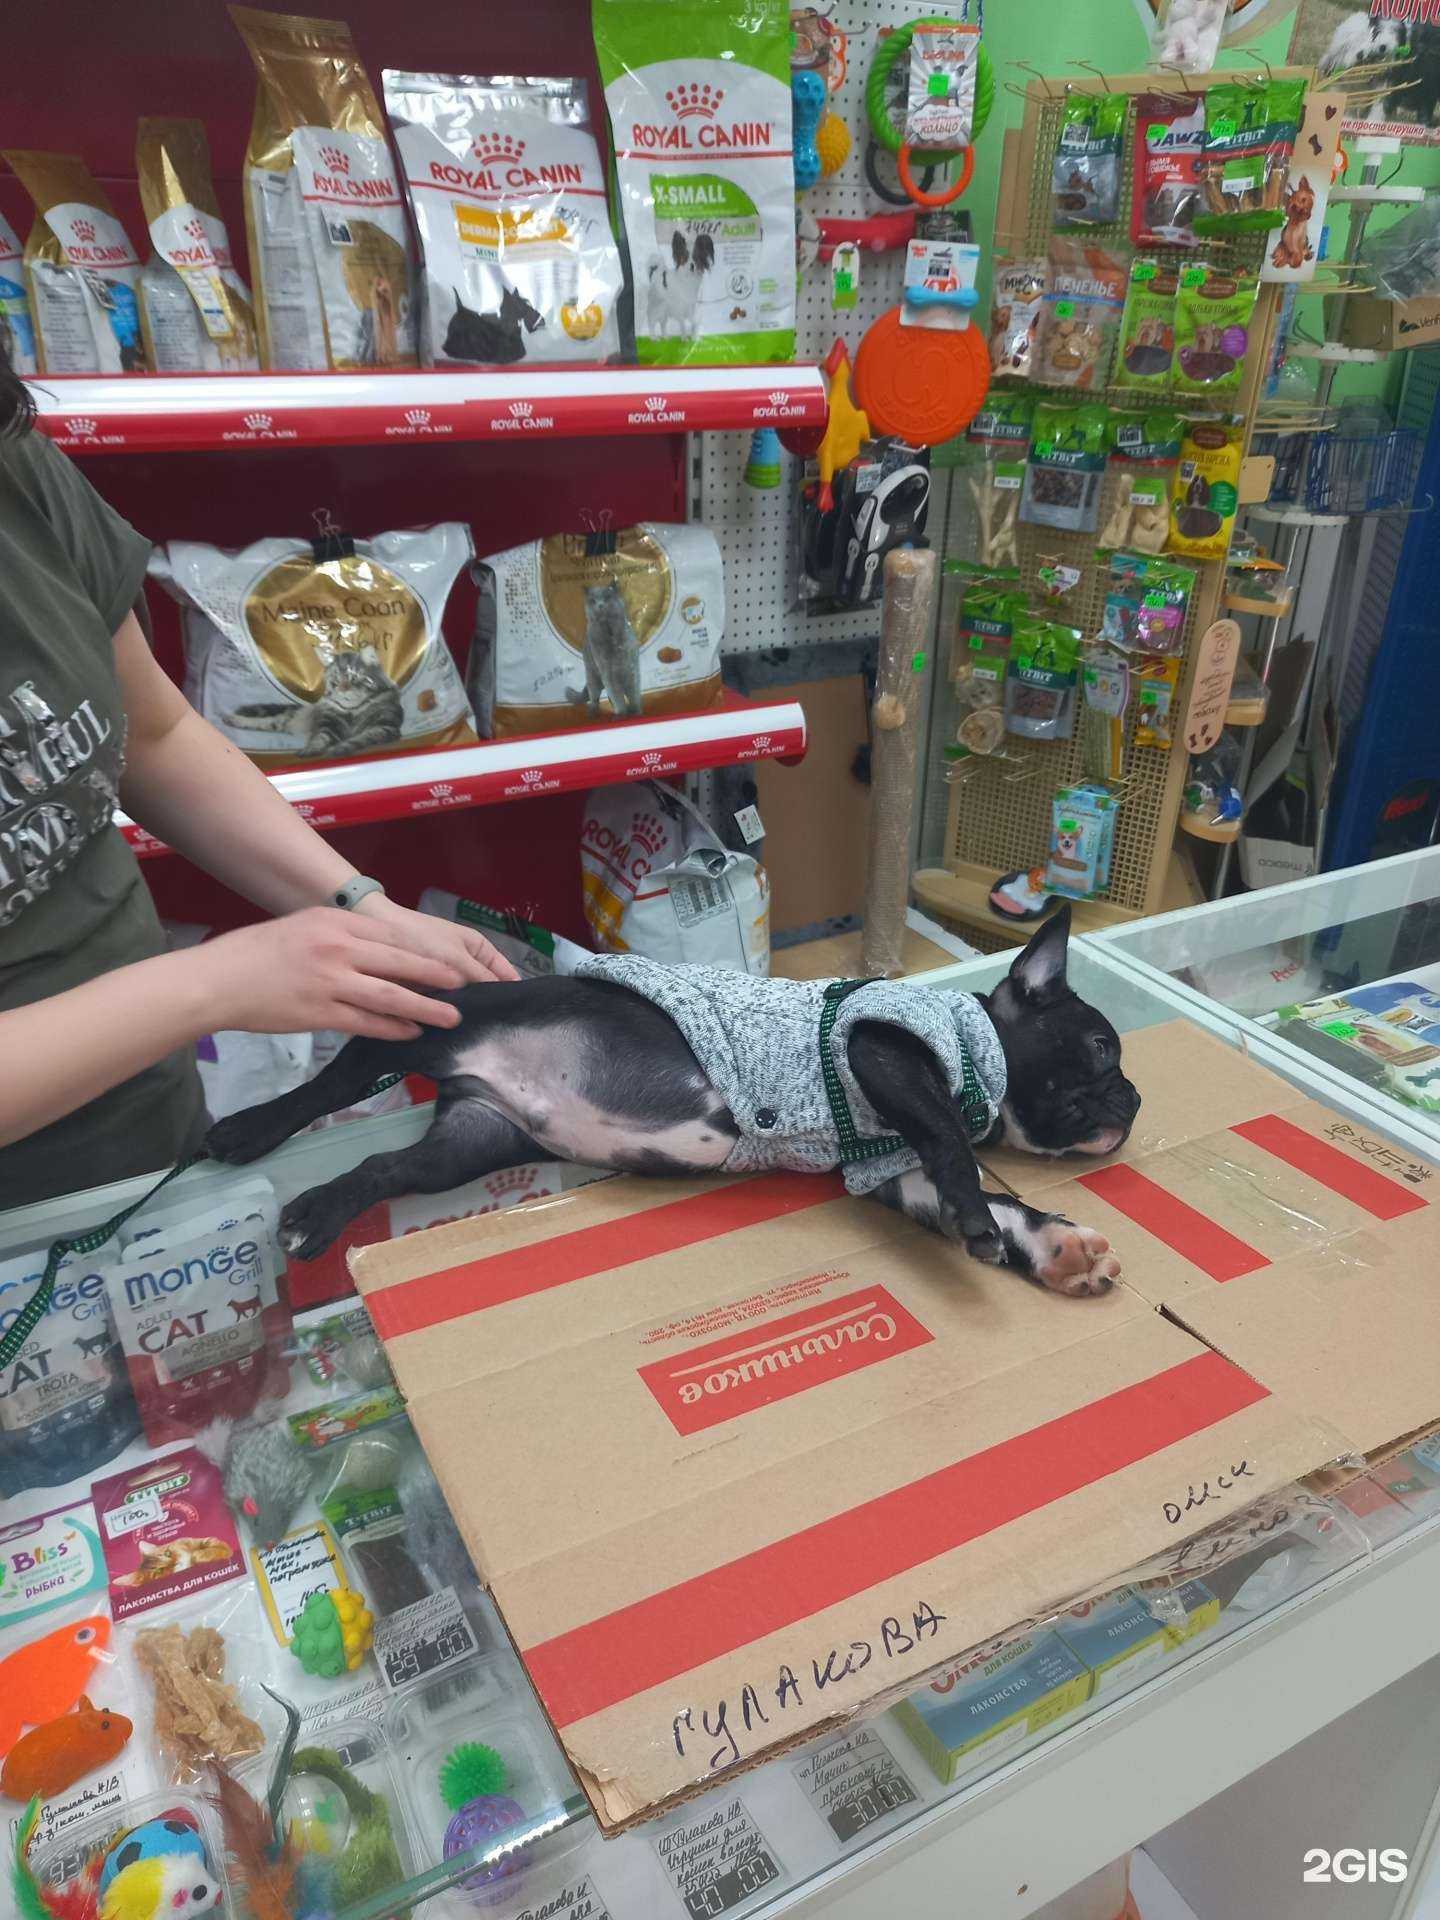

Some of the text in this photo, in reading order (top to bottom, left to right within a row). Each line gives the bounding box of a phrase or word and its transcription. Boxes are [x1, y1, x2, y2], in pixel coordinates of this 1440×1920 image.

[633, 122, 772, 149] ROYAL CANIN
[429, 161, 585, 192] ROYAL CANIN
[654, 184, 726, 206] X-SMALL
[475, 246, 499, 258] MINI
[1054, 275, 1118, 297] ПЕЧЕНЬЕ
[491, 415, 554, 430] ROYAL CANIN
[628, 410, 685, 424] ROYAL CANIN
[753, 405, 806, 418] ROYAL CANIN
[342, 596, 407, 619] Coon
[583, 818, 633, 871] ROYAL
[228, 1256, 264, 1287] Grill
[71, 1288, 112, 1322] Grill
[138, 1309, 209, 1355] CAT
[181, 1329, 241, 1357] AGNELLO
[677, 1312, 898, 1405] Сальников
[35, 1372, 80, 1398] TROTA
[11, 1542, 69, 1574] Bliss
[118, 1562, 241, 1614] ЛАКОМСТВА ДЛЯ КОШЕК
[970, 1677, 1029, 1716] ЛАКОМСТВО
